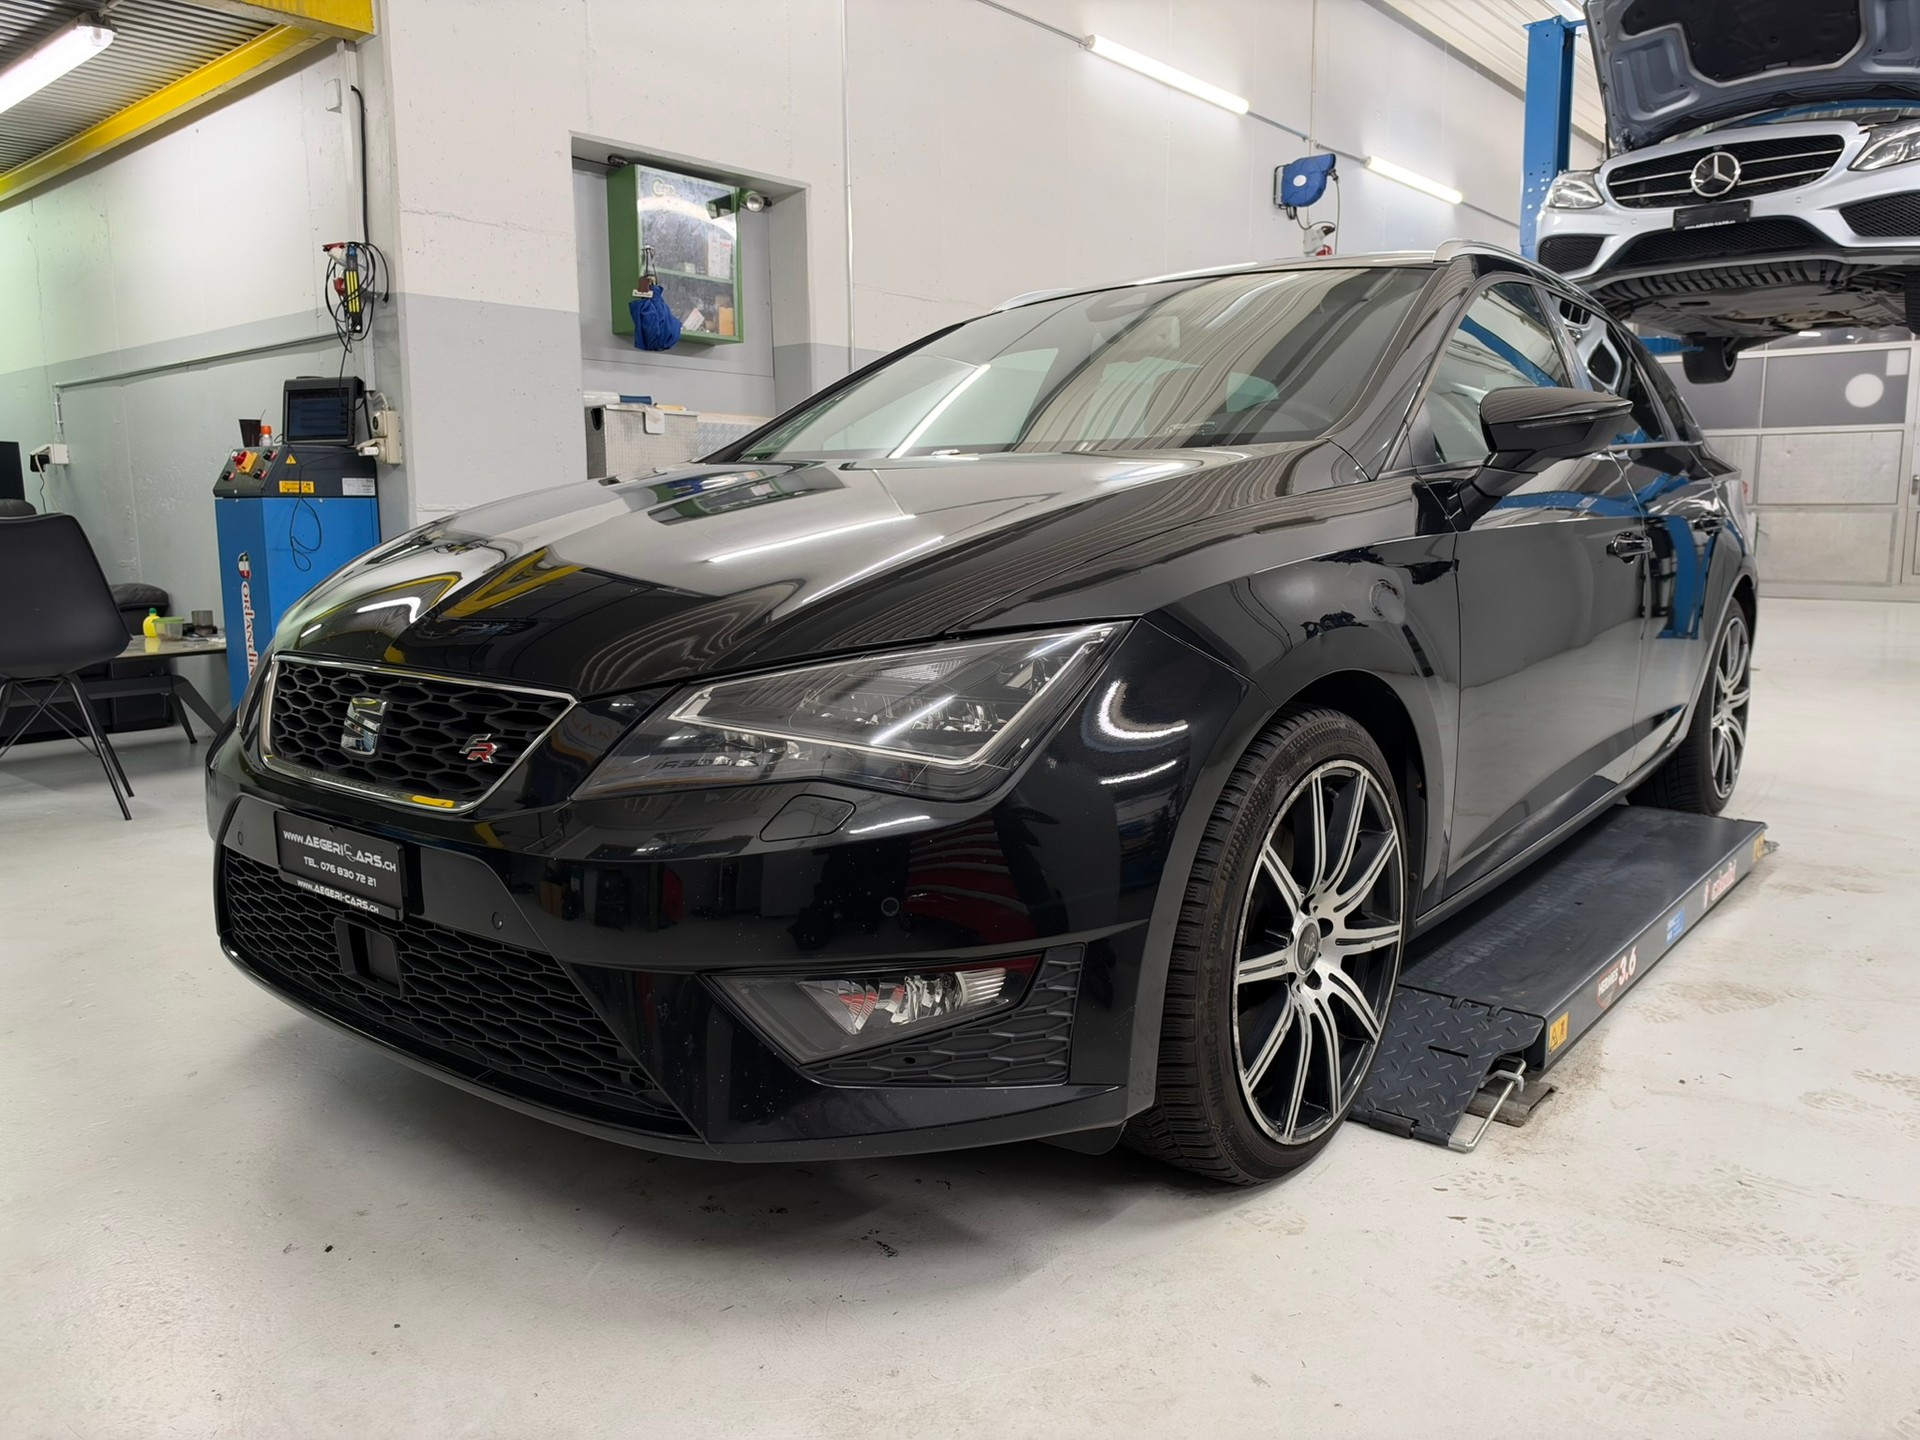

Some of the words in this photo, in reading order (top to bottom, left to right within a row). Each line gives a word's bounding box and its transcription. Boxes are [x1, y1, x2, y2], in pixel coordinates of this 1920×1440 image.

[459, 734, 498, 764] FR
[304, 856, 319, 869] TEL.
[320, 862, 336, 874] 076
[337, 867, 354, 880] 830
[355, 872, 366, 884] 72
[367, 877, 377, 887] 21
[1619, 944, 1638, 986] 3.6
